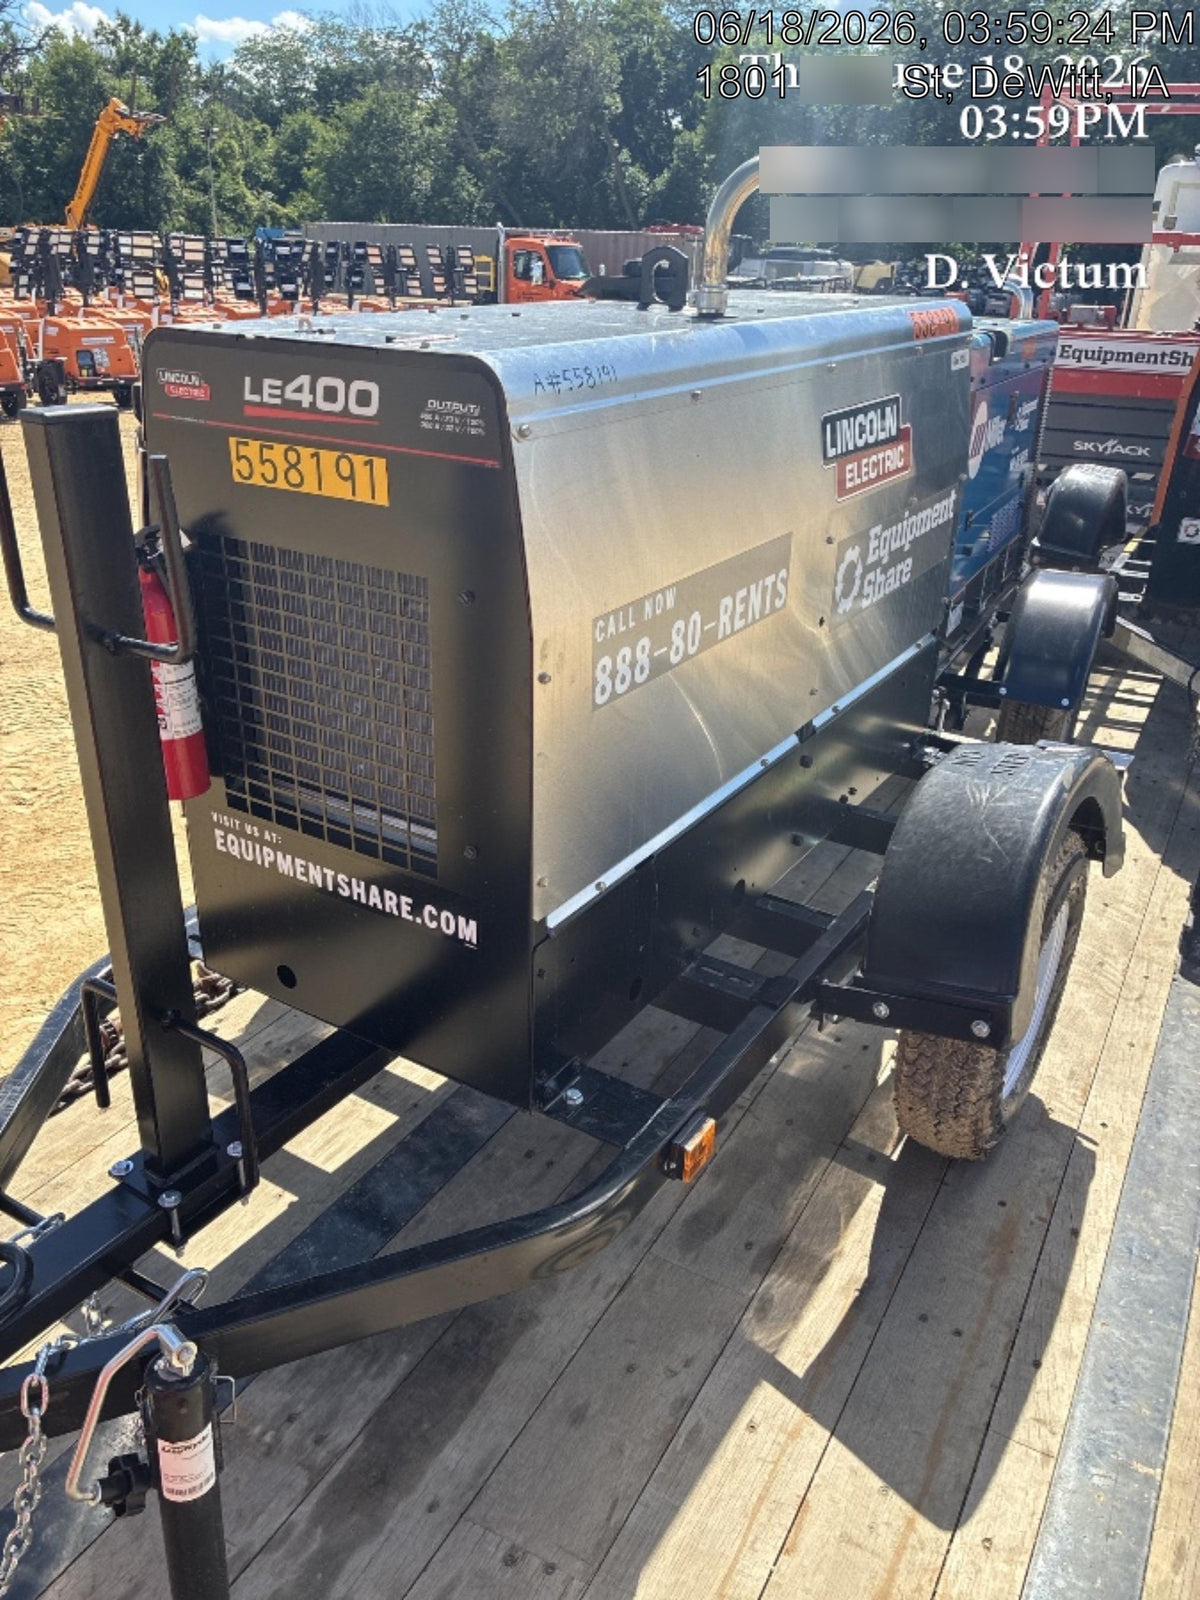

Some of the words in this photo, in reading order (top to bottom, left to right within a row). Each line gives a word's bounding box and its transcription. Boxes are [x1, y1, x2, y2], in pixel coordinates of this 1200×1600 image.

[1059, 344, 1194, 367] EquipmentSh
[244, 374, 380, 417] LE400
[825, 404, 898, 458] LINCOLN
[1073, 438, 1151, 457] SKYJACK
[234, 439, 379, 501] 558191
[845, 445, 905, 489] ELECTRIC
[865, 488, 957, 564] Equipment
[861, 556, 913, 609] Share
[594, 568, 787, 706] 888-80-RENTS
[595, 606, 636, 643] CALL
[644, 587, 677, 620] NOW
[211, 811, 240, 831] VISIT
[244, 824, 259, 838] US
[263, 829, 282, 844] AT:
[213, 828, 478, 945] EQUIPMENTSHARE.COM
